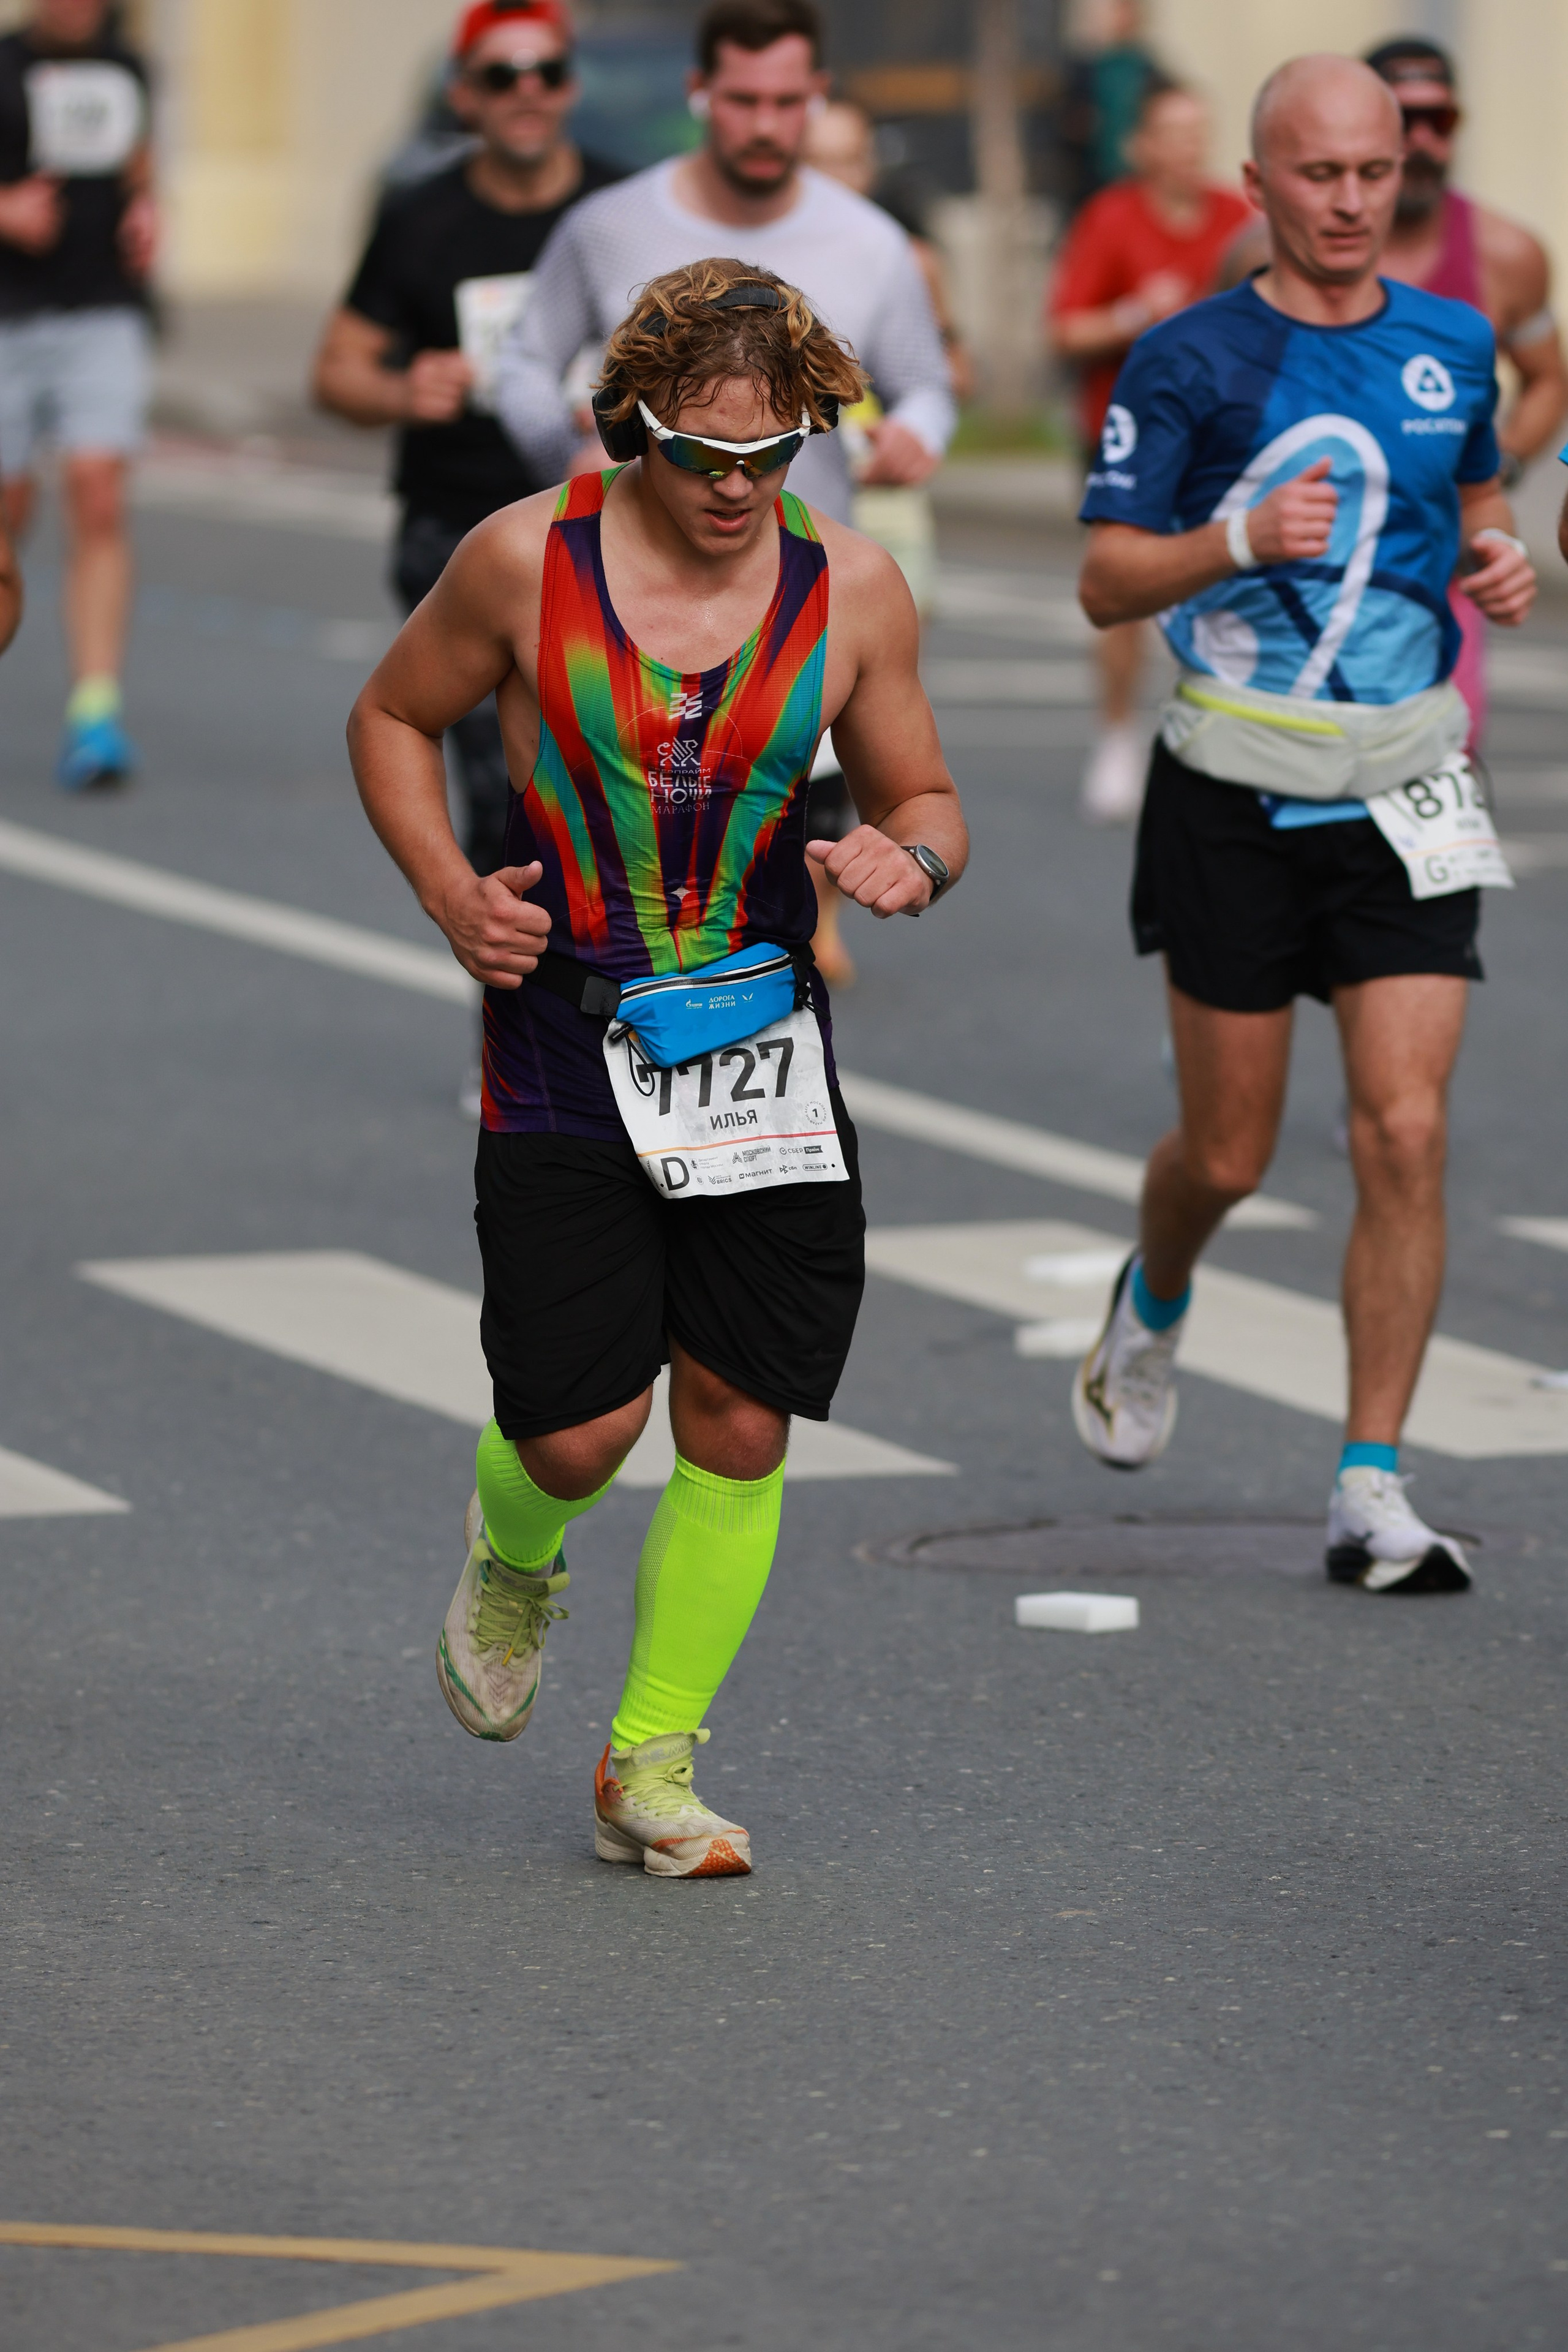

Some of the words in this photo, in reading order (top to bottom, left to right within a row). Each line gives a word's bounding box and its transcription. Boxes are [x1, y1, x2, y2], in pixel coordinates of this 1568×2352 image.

[647, 771, 711, 788] БЕЛЫЕ
[650, 788, 712, 804] НОЧИ
[652, 801, 710, 814] МАРАФОН
[709, 995, 735, 1003] ДОРОГА
[709, 1001, 736, 1009] ЖИЗНИ
[635, 1037, 794, 1117] 7727
[710, 1109, 758, 1130] ИЛЬЯ
[812, 1108, 818, 1118] 1
[742, 1145, 772, 1156] МОСКОВСКИЙ
[660, 1156, 690, 1191] D
[745, 1169, 772, 1178] магнит
